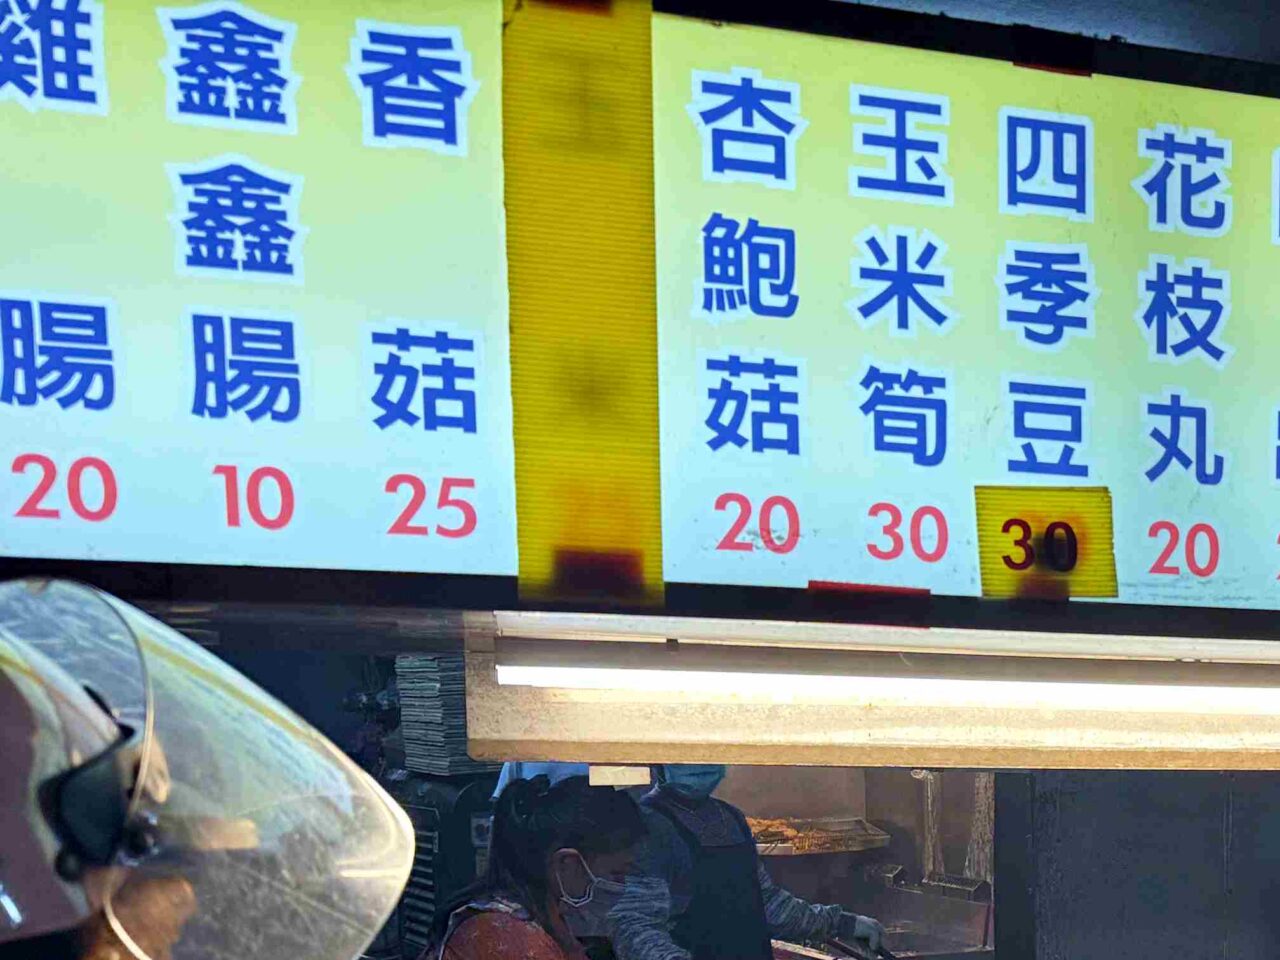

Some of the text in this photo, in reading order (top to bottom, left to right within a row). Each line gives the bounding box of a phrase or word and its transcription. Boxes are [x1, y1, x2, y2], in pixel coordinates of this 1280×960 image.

[171, 9, 301, 423] 鑫鑫腸
[359, 30, 477, 433] 香菇
[700, 78, 801, 456] 杏鮑菇
[858, 95, 948, 468] 玉米筍
[1005, 115, 1090, 478] 四季豆
[1143, 132, 1226, 485] 花枝丸
[11, 453, 118, 522] 20
[213, 464, 295, 530] 10
[384, 473, 478, 538] 25
[714, 493, 800, 554] 20
[867, 502, 949, 563] 30
[1002, 518, 1079, 573] 30
[1148, 521, 1220, 577] 20
